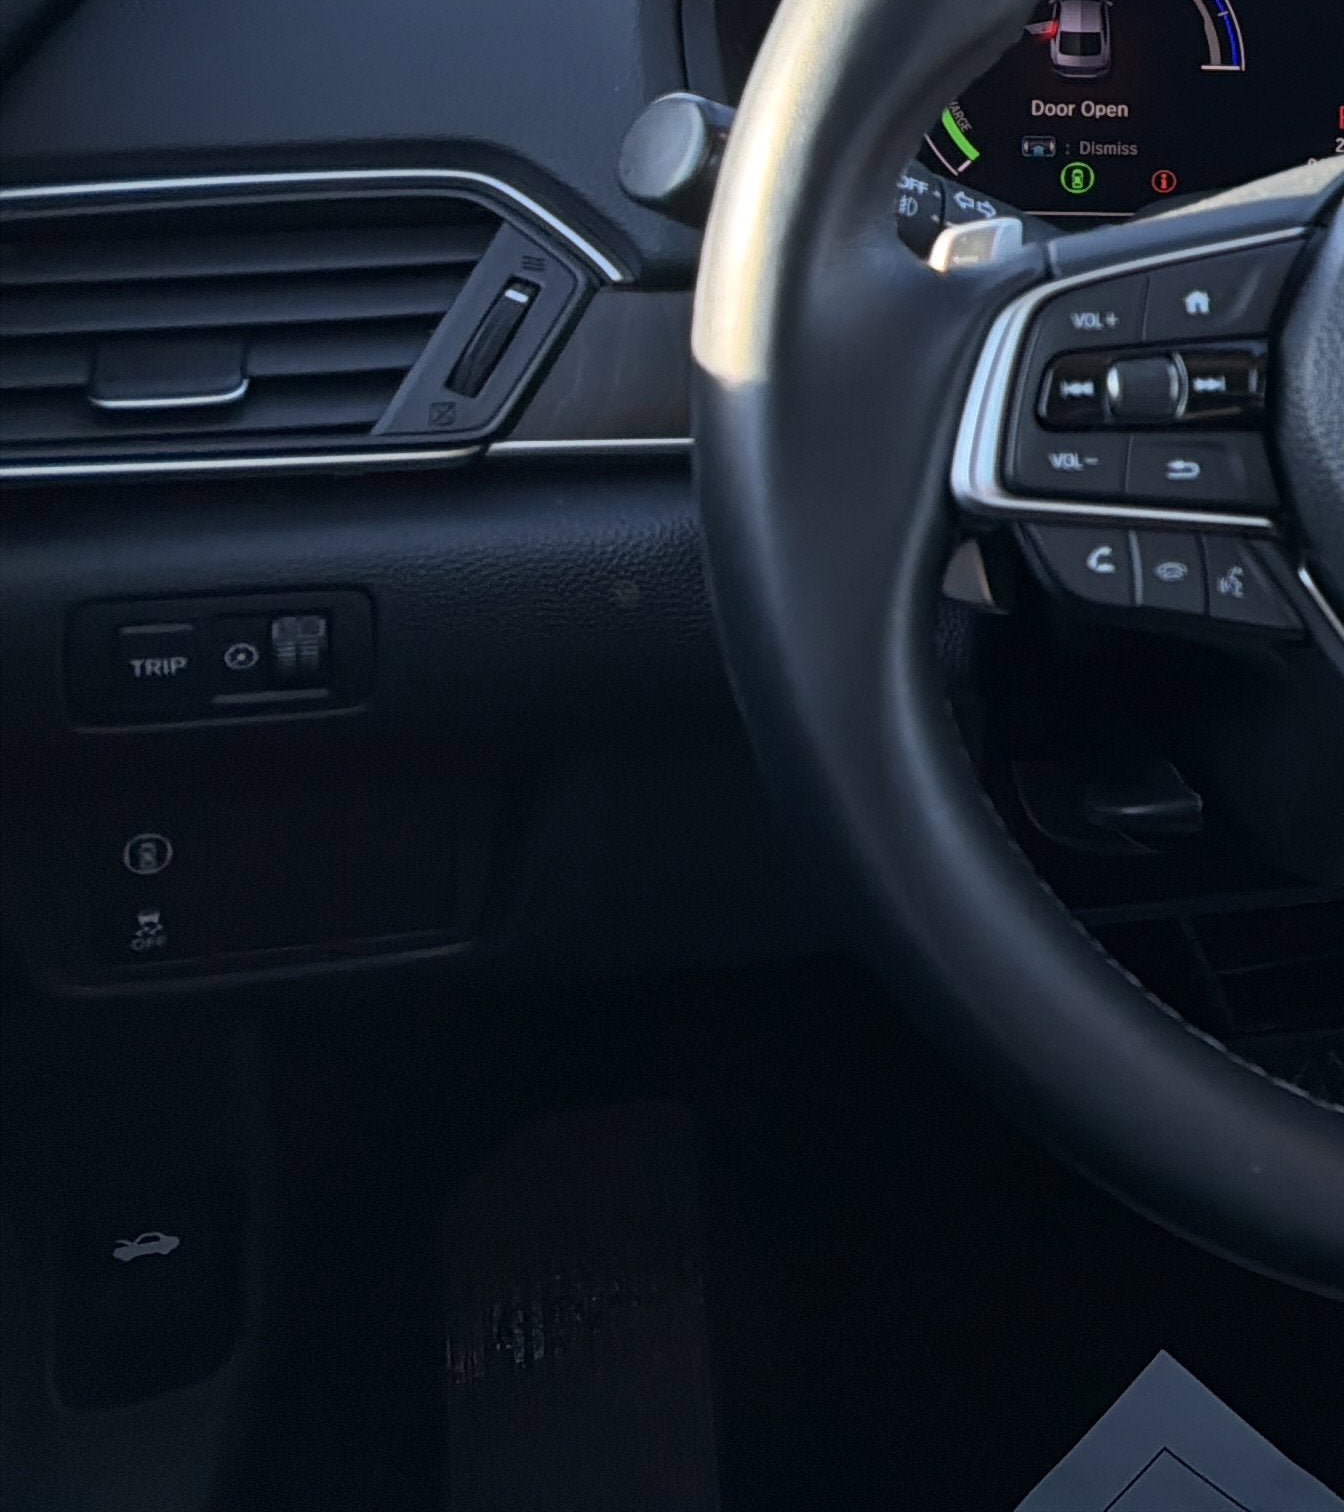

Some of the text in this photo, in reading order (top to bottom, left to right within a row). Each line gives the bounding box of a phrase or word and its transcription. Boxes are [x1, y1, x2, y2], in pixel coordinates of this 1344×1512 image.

[1031, 99, 1129, 121] Door Open
[1078, 141, 1138, 156] Dismiss
[129, 656, 188, 678] TRIP
